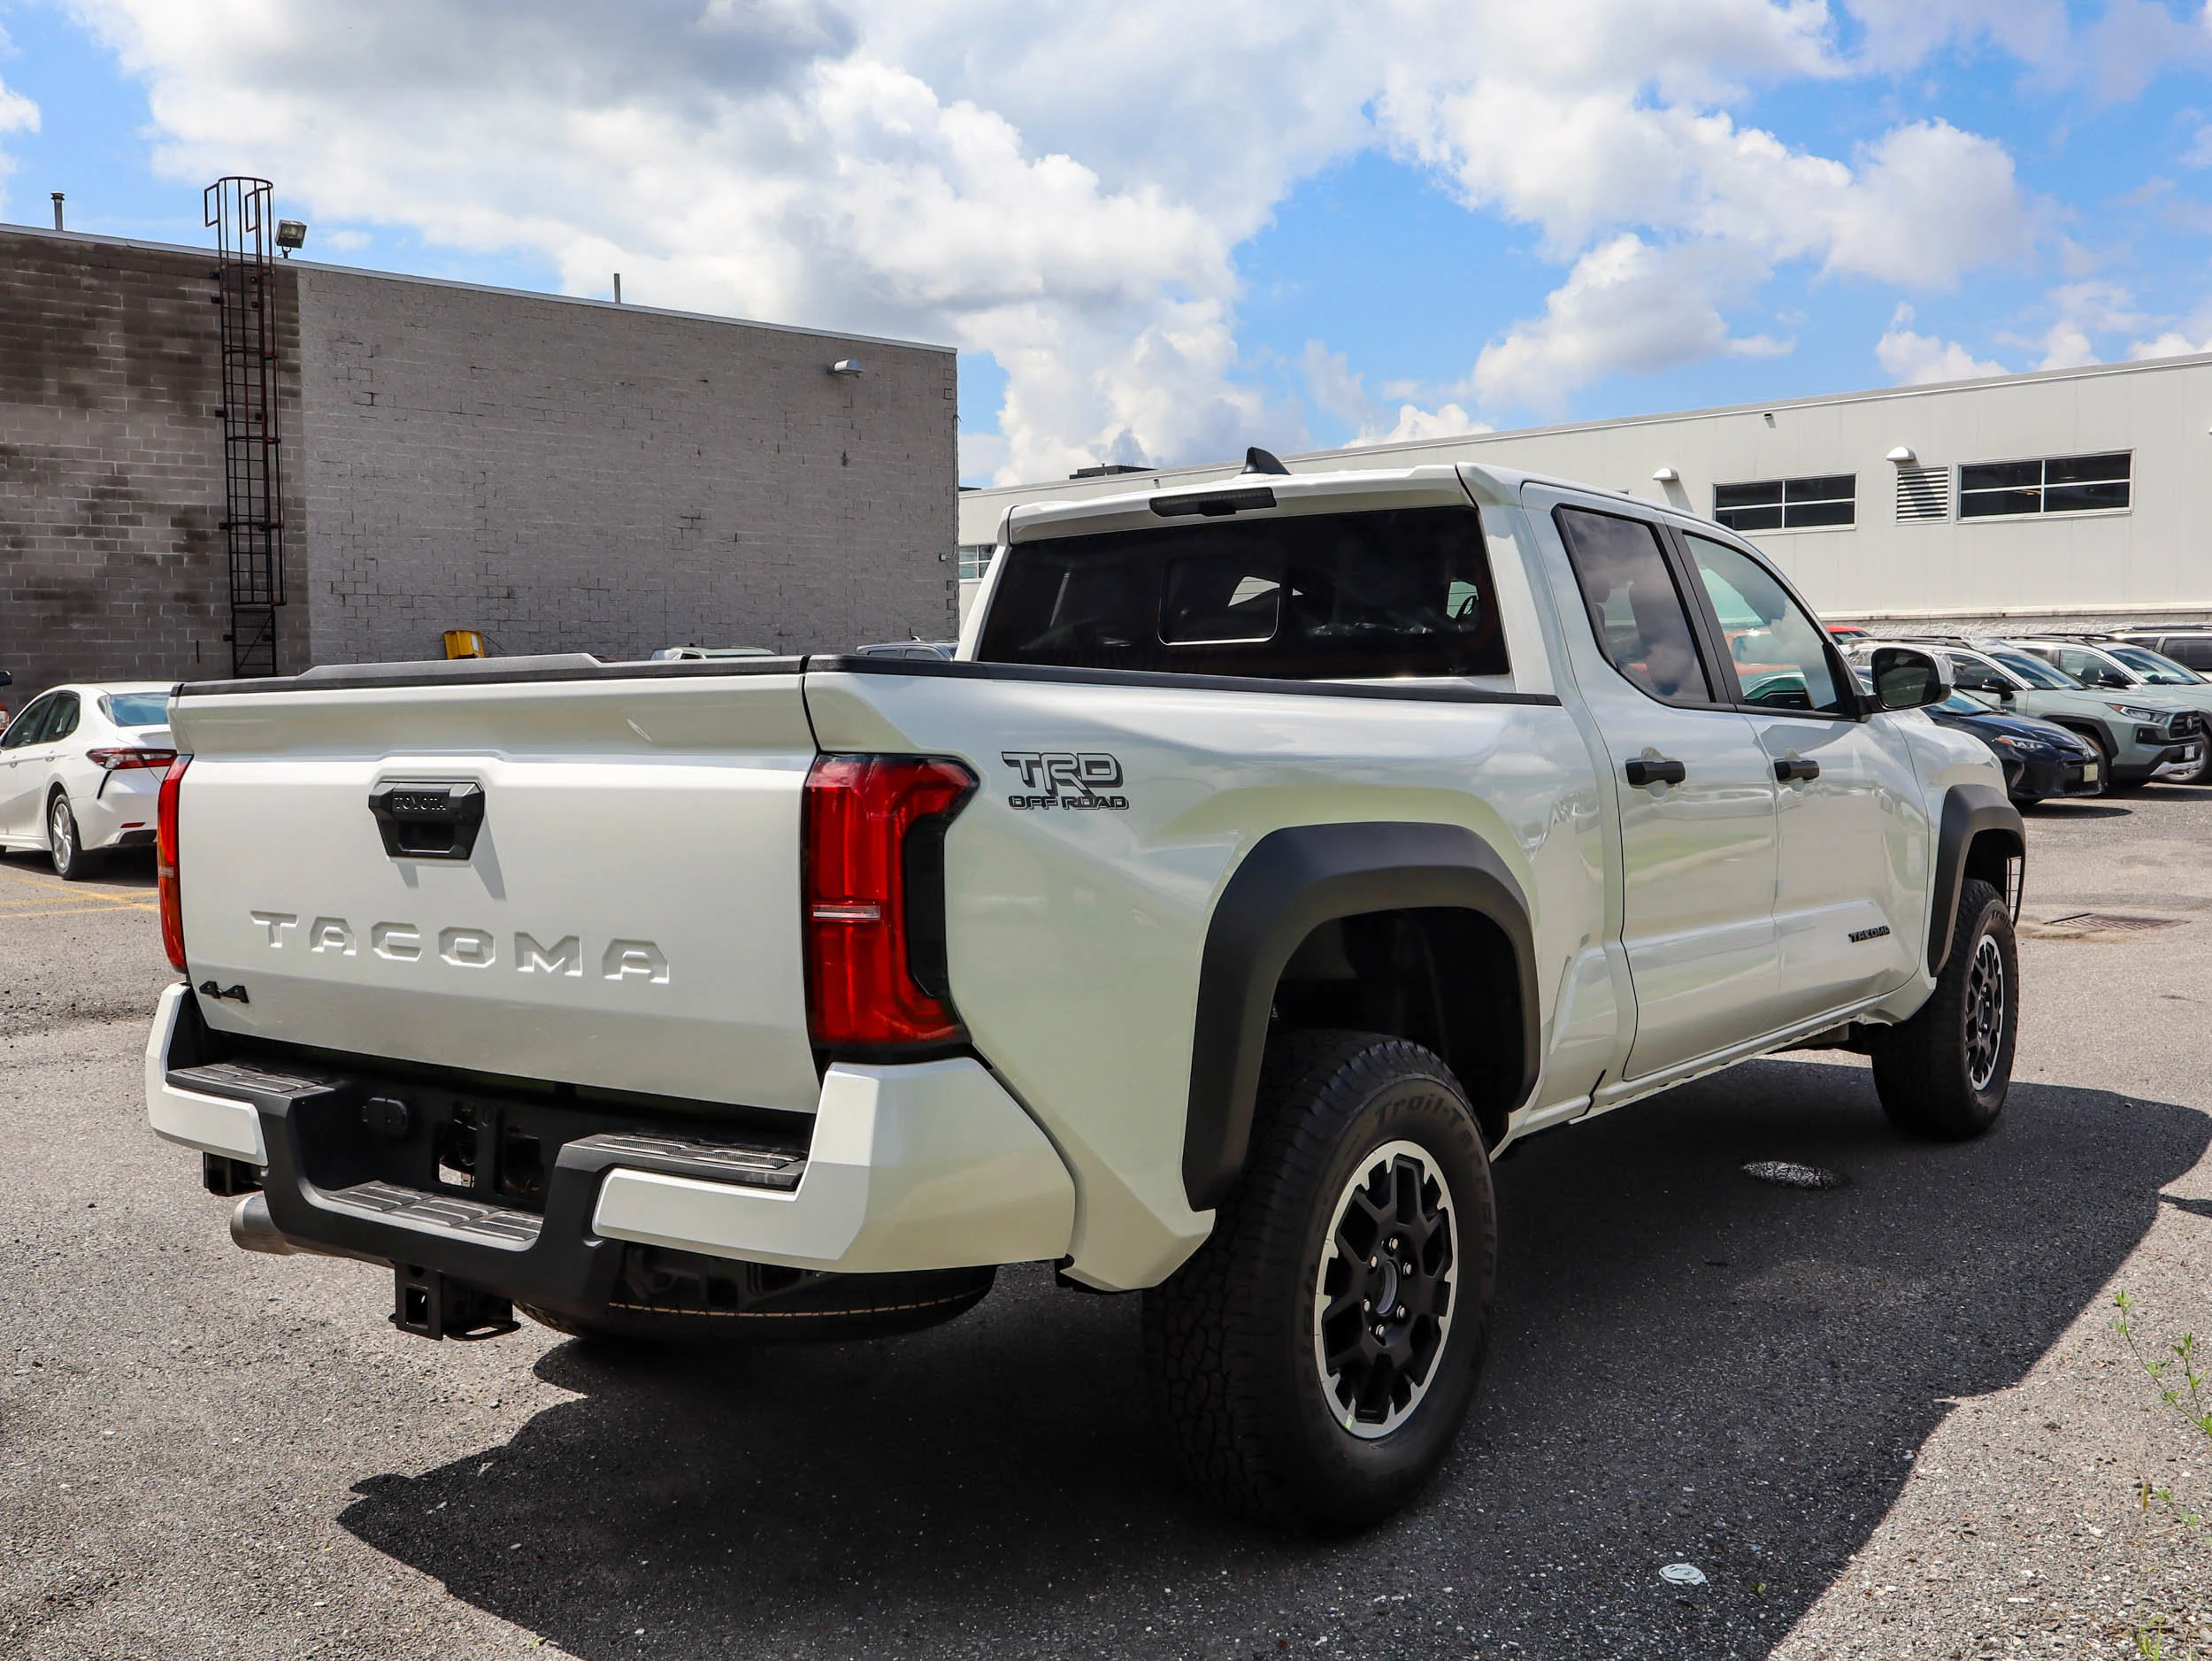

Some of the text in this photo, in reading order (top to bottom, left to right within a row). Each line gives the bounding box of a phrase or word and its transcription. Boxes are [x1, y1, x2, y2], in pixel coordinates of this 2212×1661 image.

[1001, 751, 1124, 796] TRD
[394, 795, 447, 811] TOYOTA
[1008, 796, 1130, 811] OFF ROAD
[1847, 925, 1891, 943] TACOMA
[250, 909, 671, 985] TACOMA
[199, 980, 250, 1004] 44
